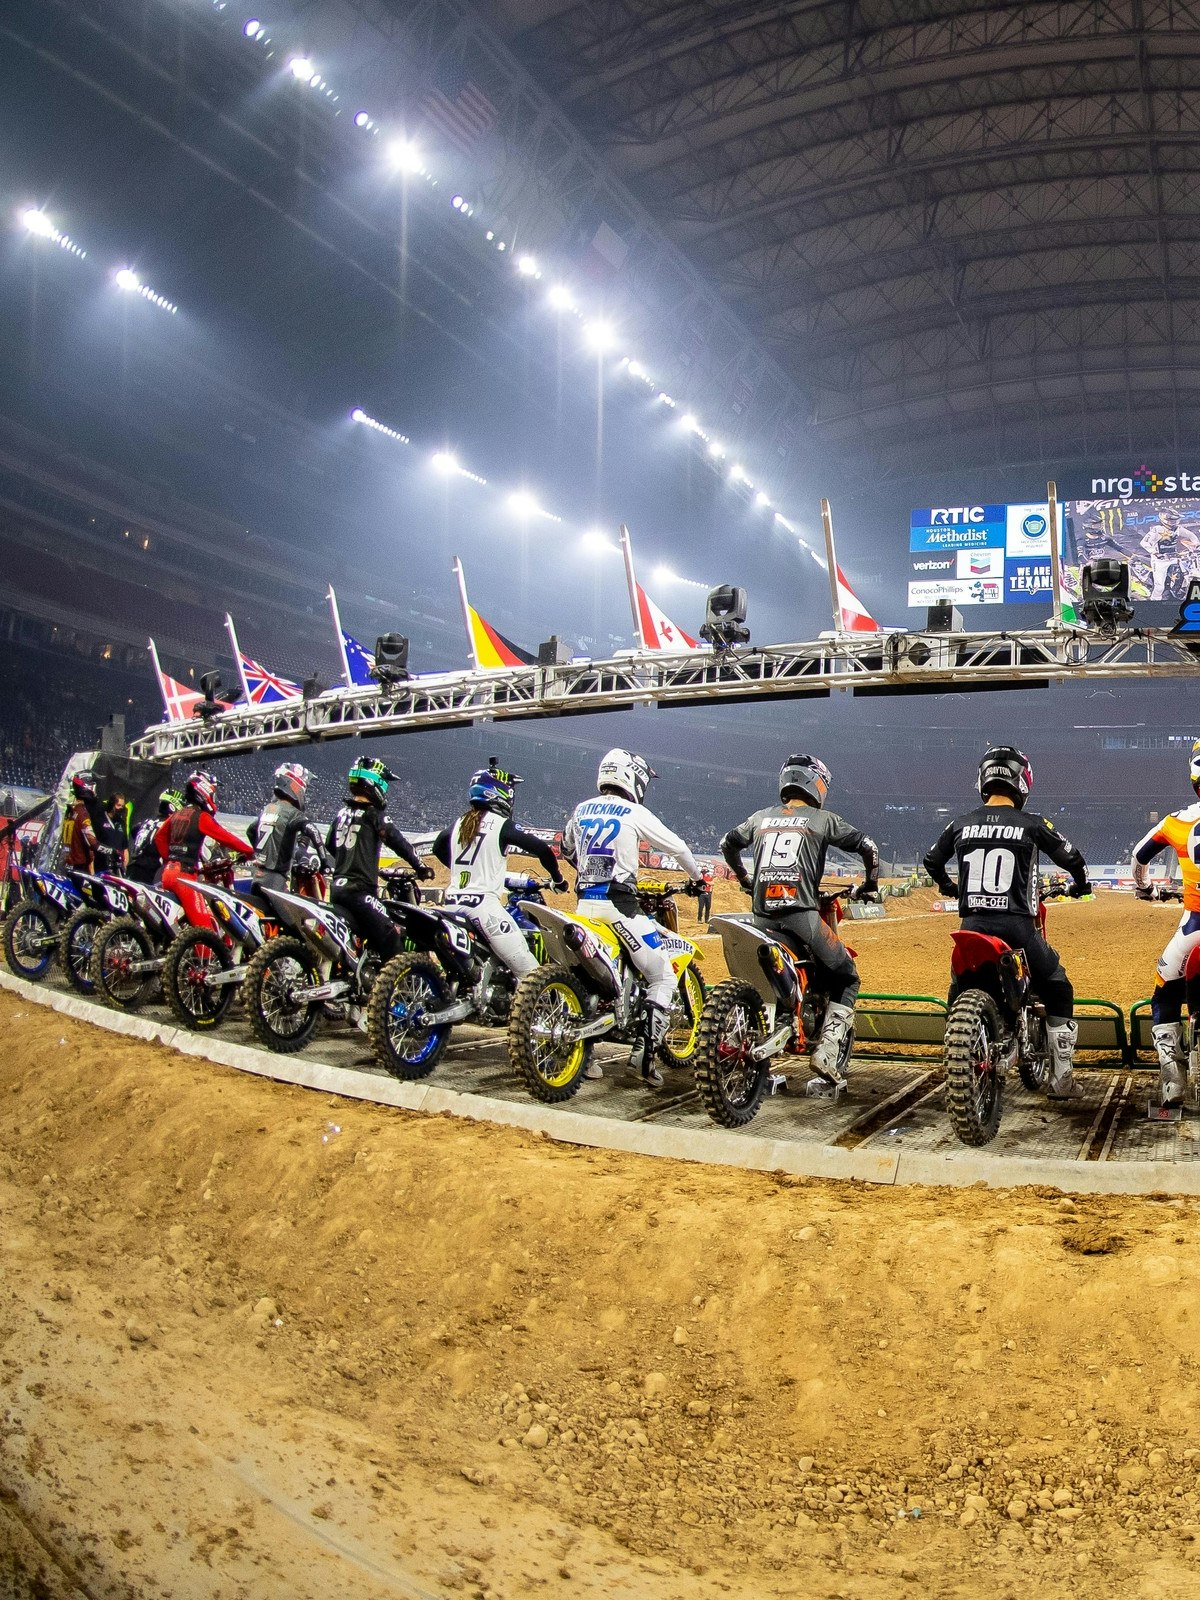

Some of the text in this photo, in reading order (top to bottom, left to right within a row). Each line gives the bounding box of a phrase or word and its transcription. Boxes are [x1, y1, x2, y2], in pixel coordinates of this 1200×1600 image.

[1091, 478, 1133, 498] nrg
[931, 507, 985, 525] RTIC
[926, 529, 987, 544] Methodist
[913, 559, 950, 571] verizon
[1017, 566, 1050, 576] WE ARE
[911, 584, 963, 595] ConocoPhillips
[985, 765, 1012, 777] BRAYTON
[986, 814, 1000, 823] FLY
[579, 818, 621, 856] 722
[962, 825, 1024, 840] BRAYTON
[760, 831, 804, 869] 19
[963, 848, 1016, 894] 10
[765, 884, 798, 898] KTM
[970, 896, 1007, 908] Muc-Off
[325, 913, 347, 941] 36
[613, 922, 640, 951] SUZUKI
